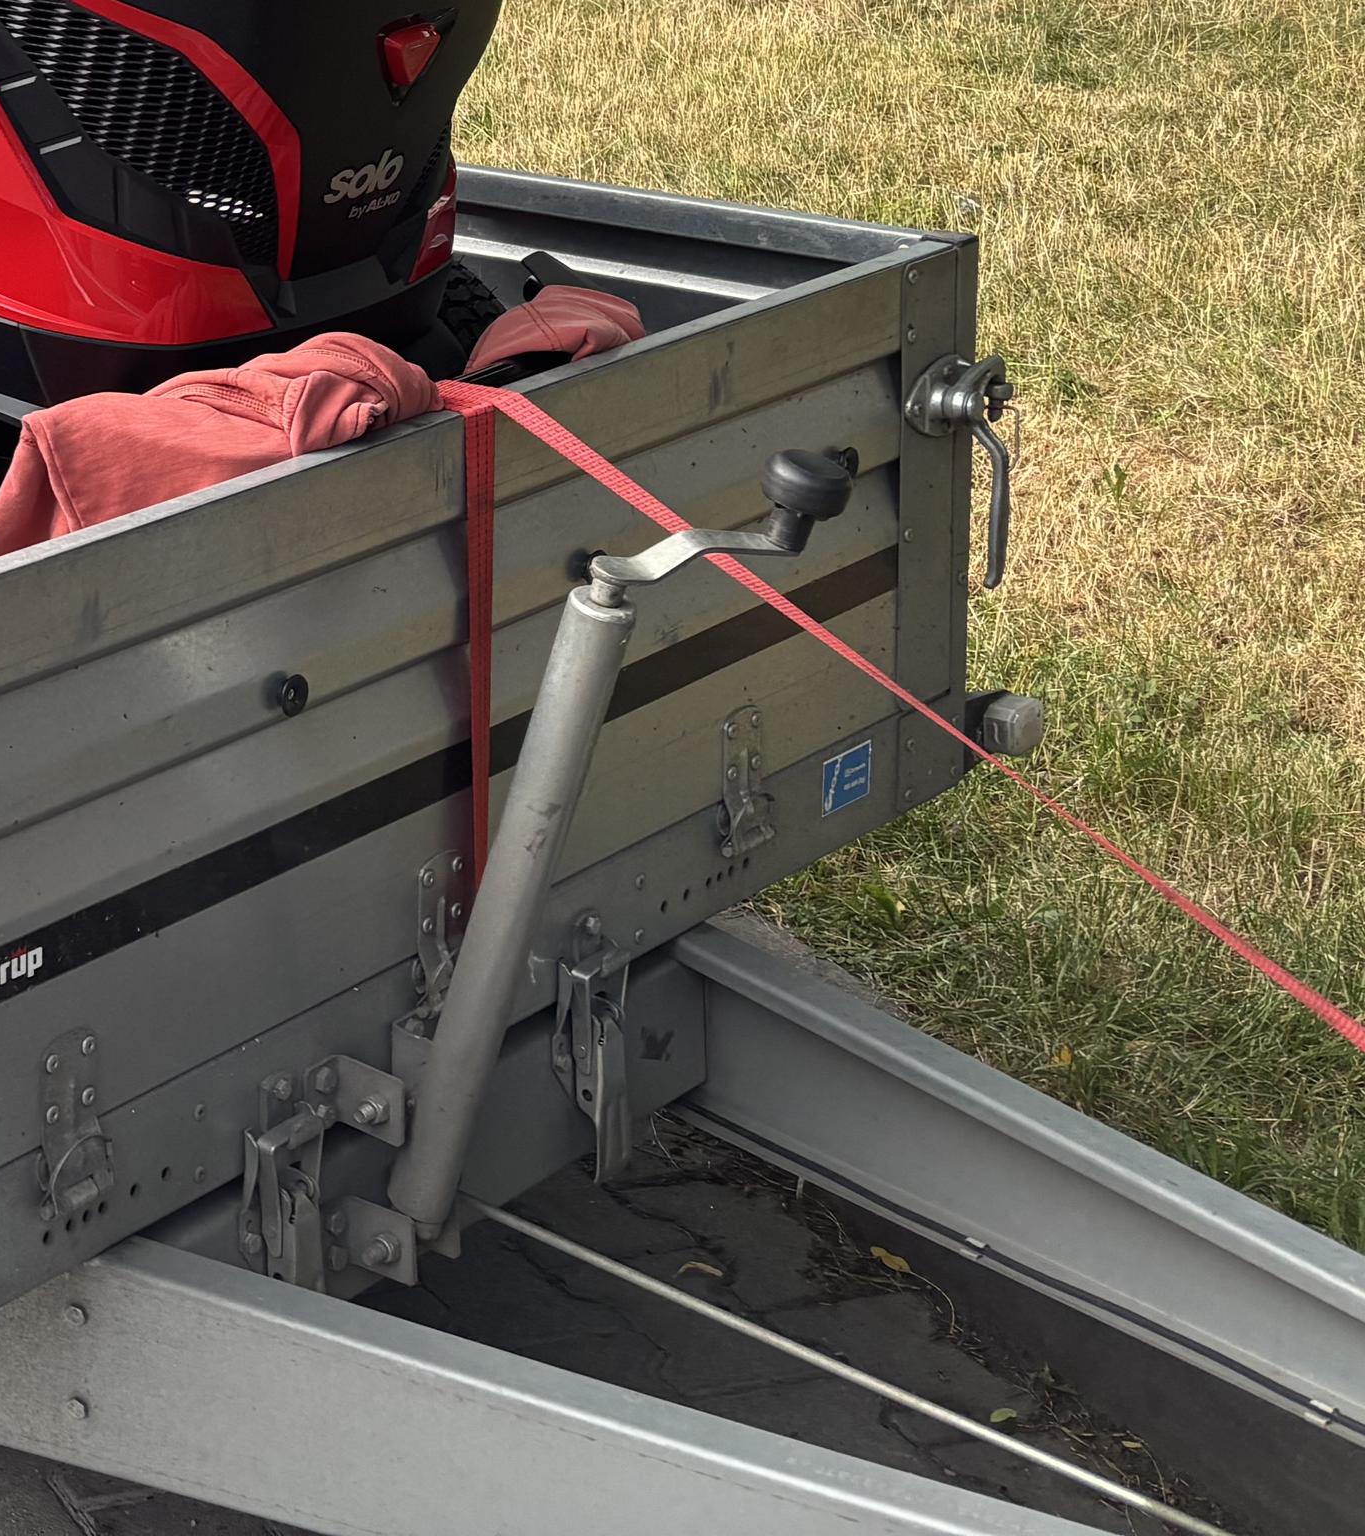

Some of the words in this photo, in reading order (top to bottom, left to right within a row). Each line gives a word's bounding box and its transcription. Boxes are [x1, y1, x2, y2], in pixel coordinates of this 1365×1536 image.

[323, 148, 405, 205] solo
[348, 205, 367, 220] by
[365, 190, 401, 214] AL-KO
